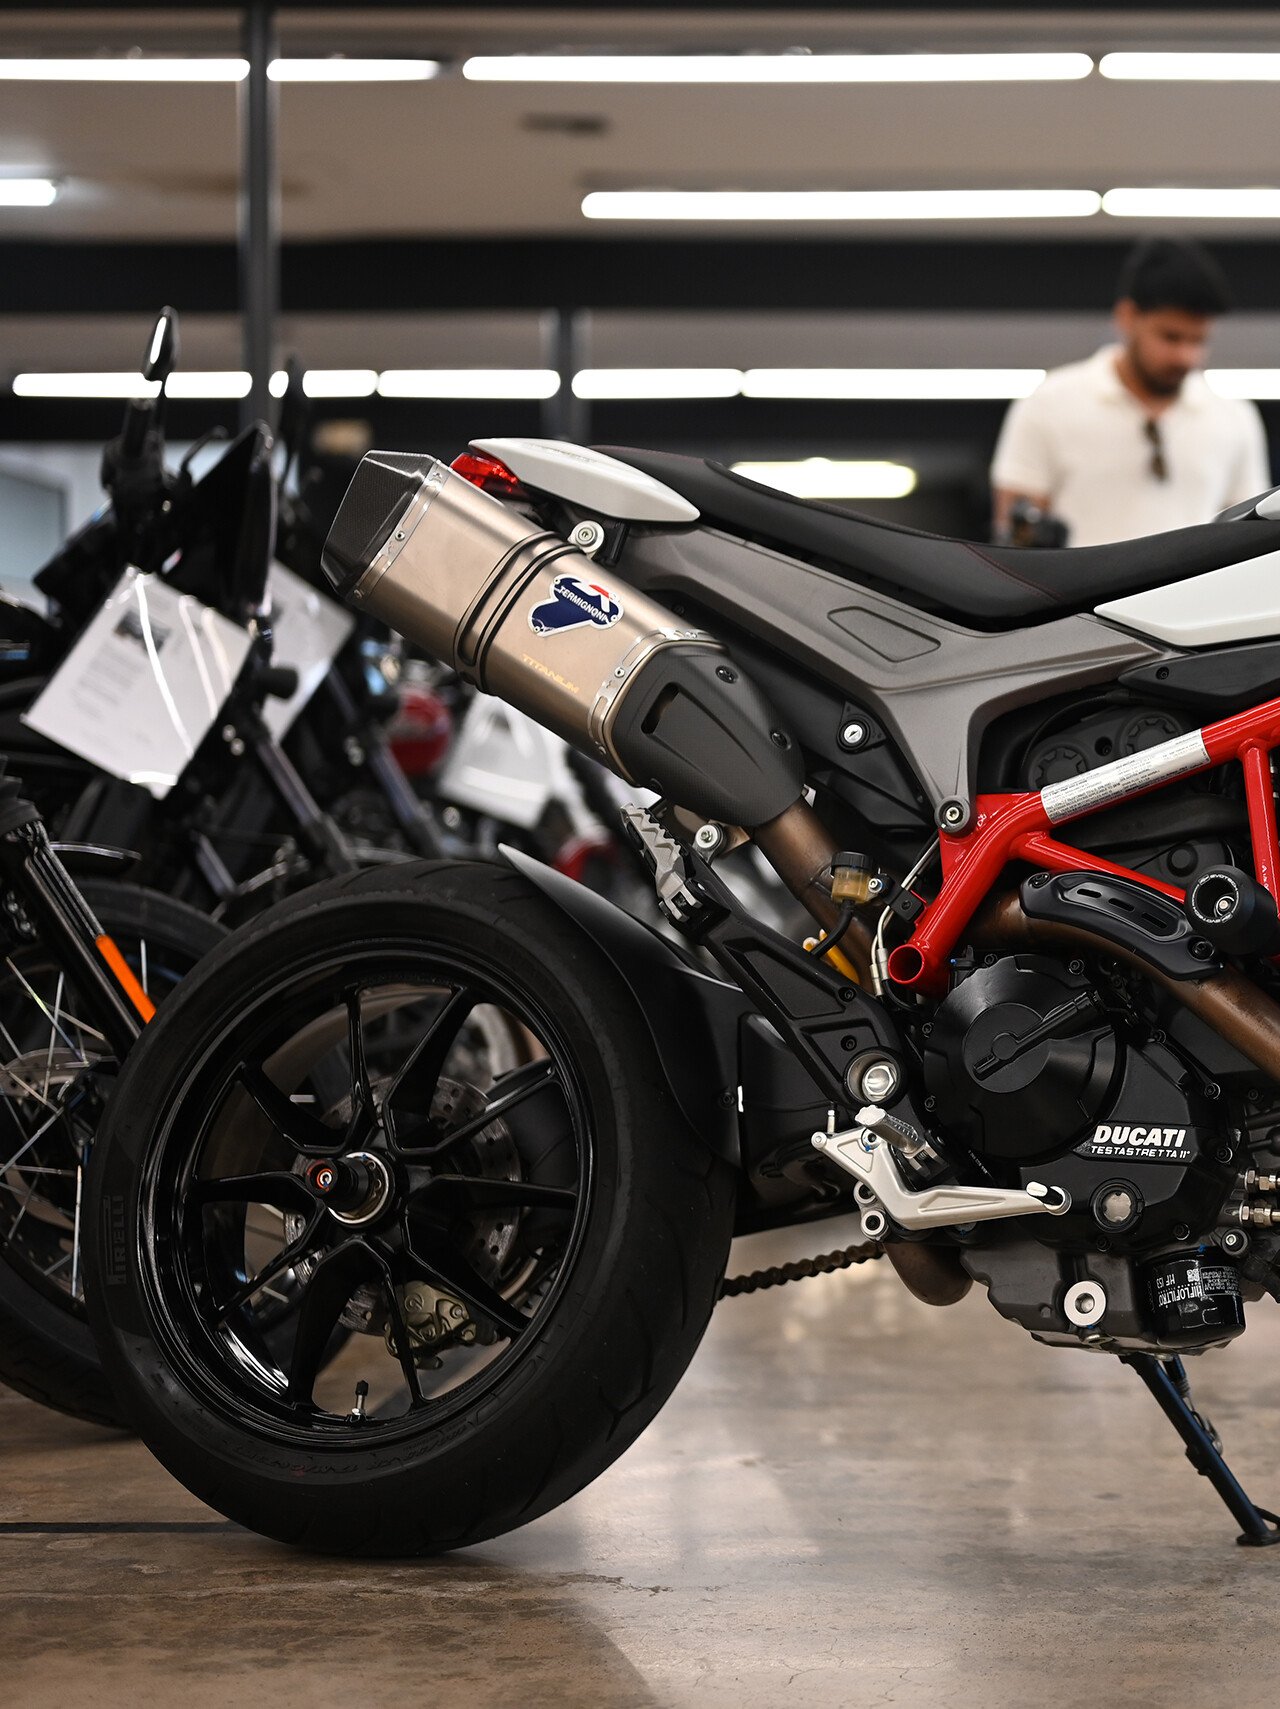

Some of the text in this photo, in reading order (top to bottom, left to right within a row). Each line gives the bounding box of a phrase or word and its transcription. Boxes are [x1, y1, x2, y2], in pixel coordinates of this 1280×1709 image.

[523, 653, 580, 693] TITANIUM
[1093, 1125, 1186, 1147] DUCATI
[1091, 1145, 1177, 1158] TESTASTRETTA
[1158, 1282, 1203, 1308] HIFLOFILTRO
